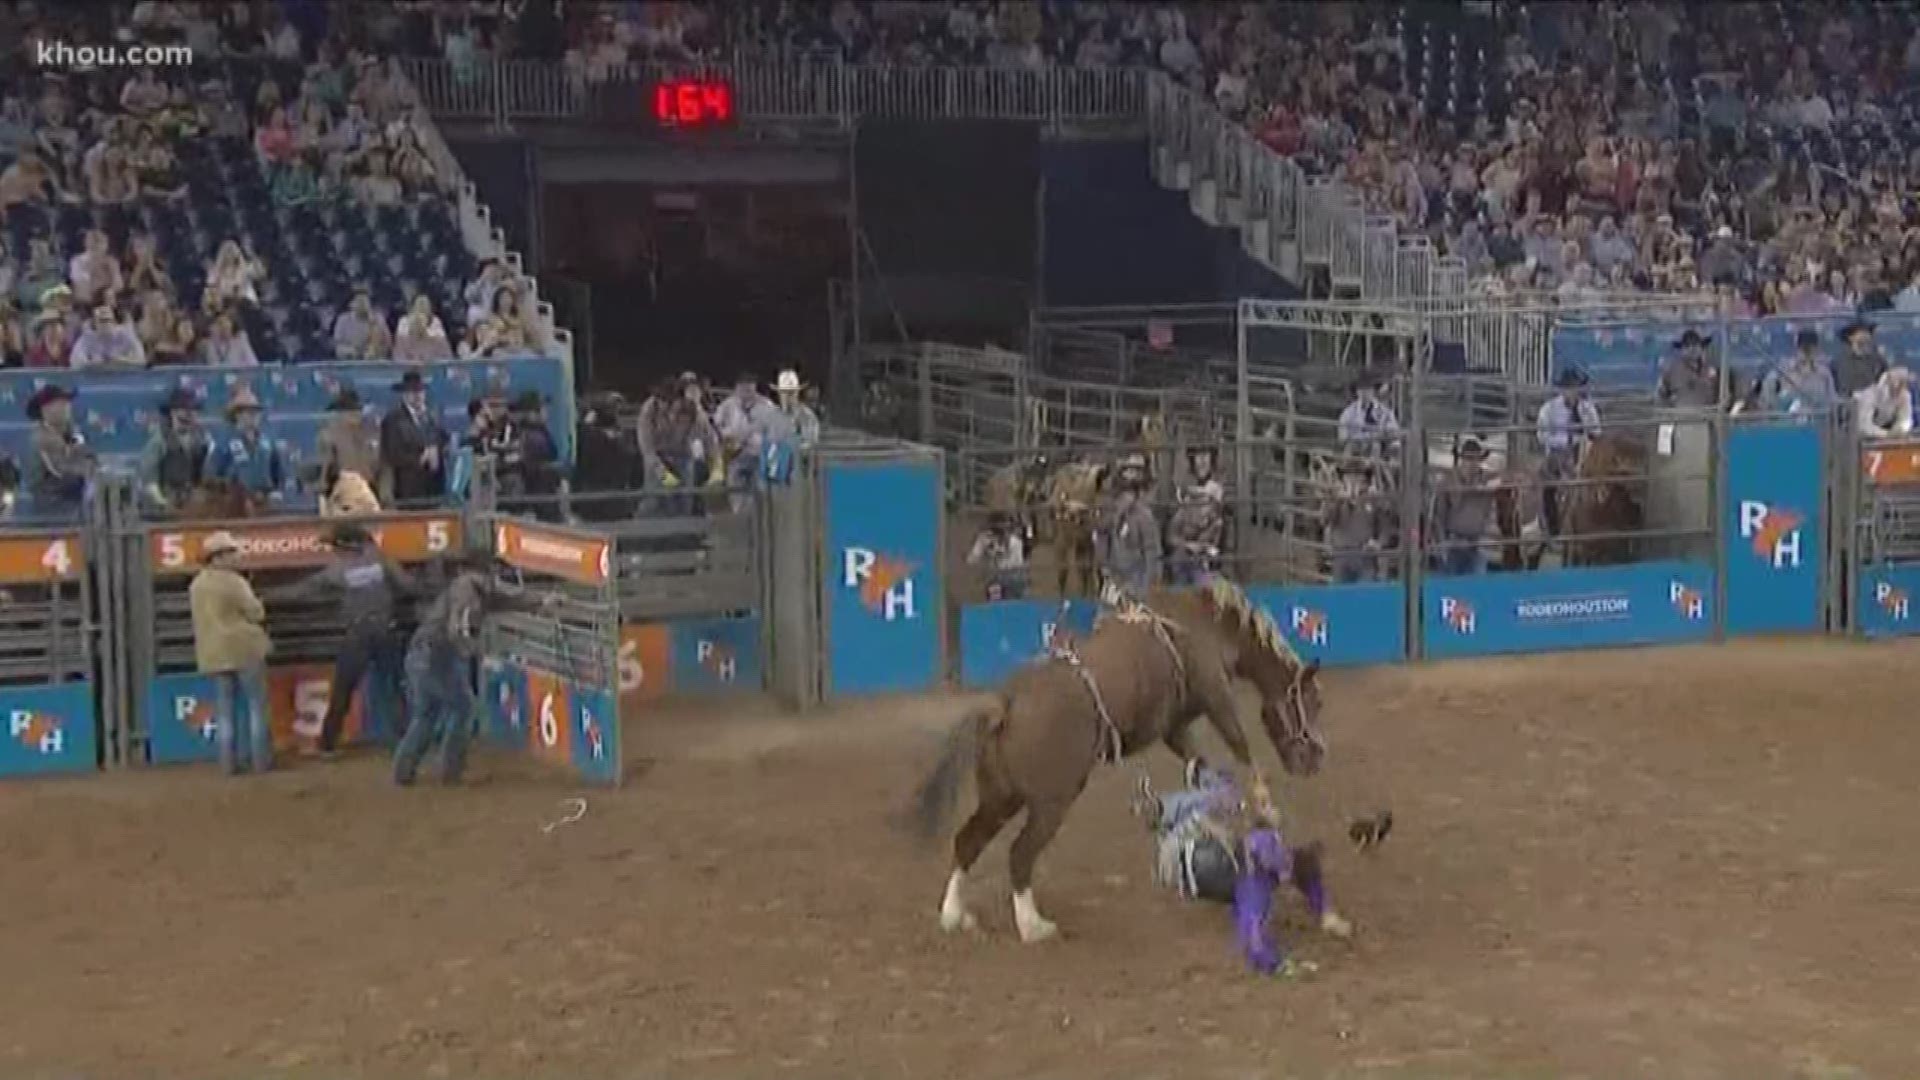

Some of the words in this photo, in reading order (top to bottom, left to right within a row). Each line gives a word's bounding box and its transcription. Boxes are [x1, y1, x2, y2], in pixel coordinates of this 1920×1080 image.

[1867, 452, 1883, 477] 7
[162, 534, 185, 566] 5
[427, 521, 448, 550] 5
[41, 540, 71, 574] 4
[293, 681, 328, 736] 5
[540, 692, 557, 746] 6
